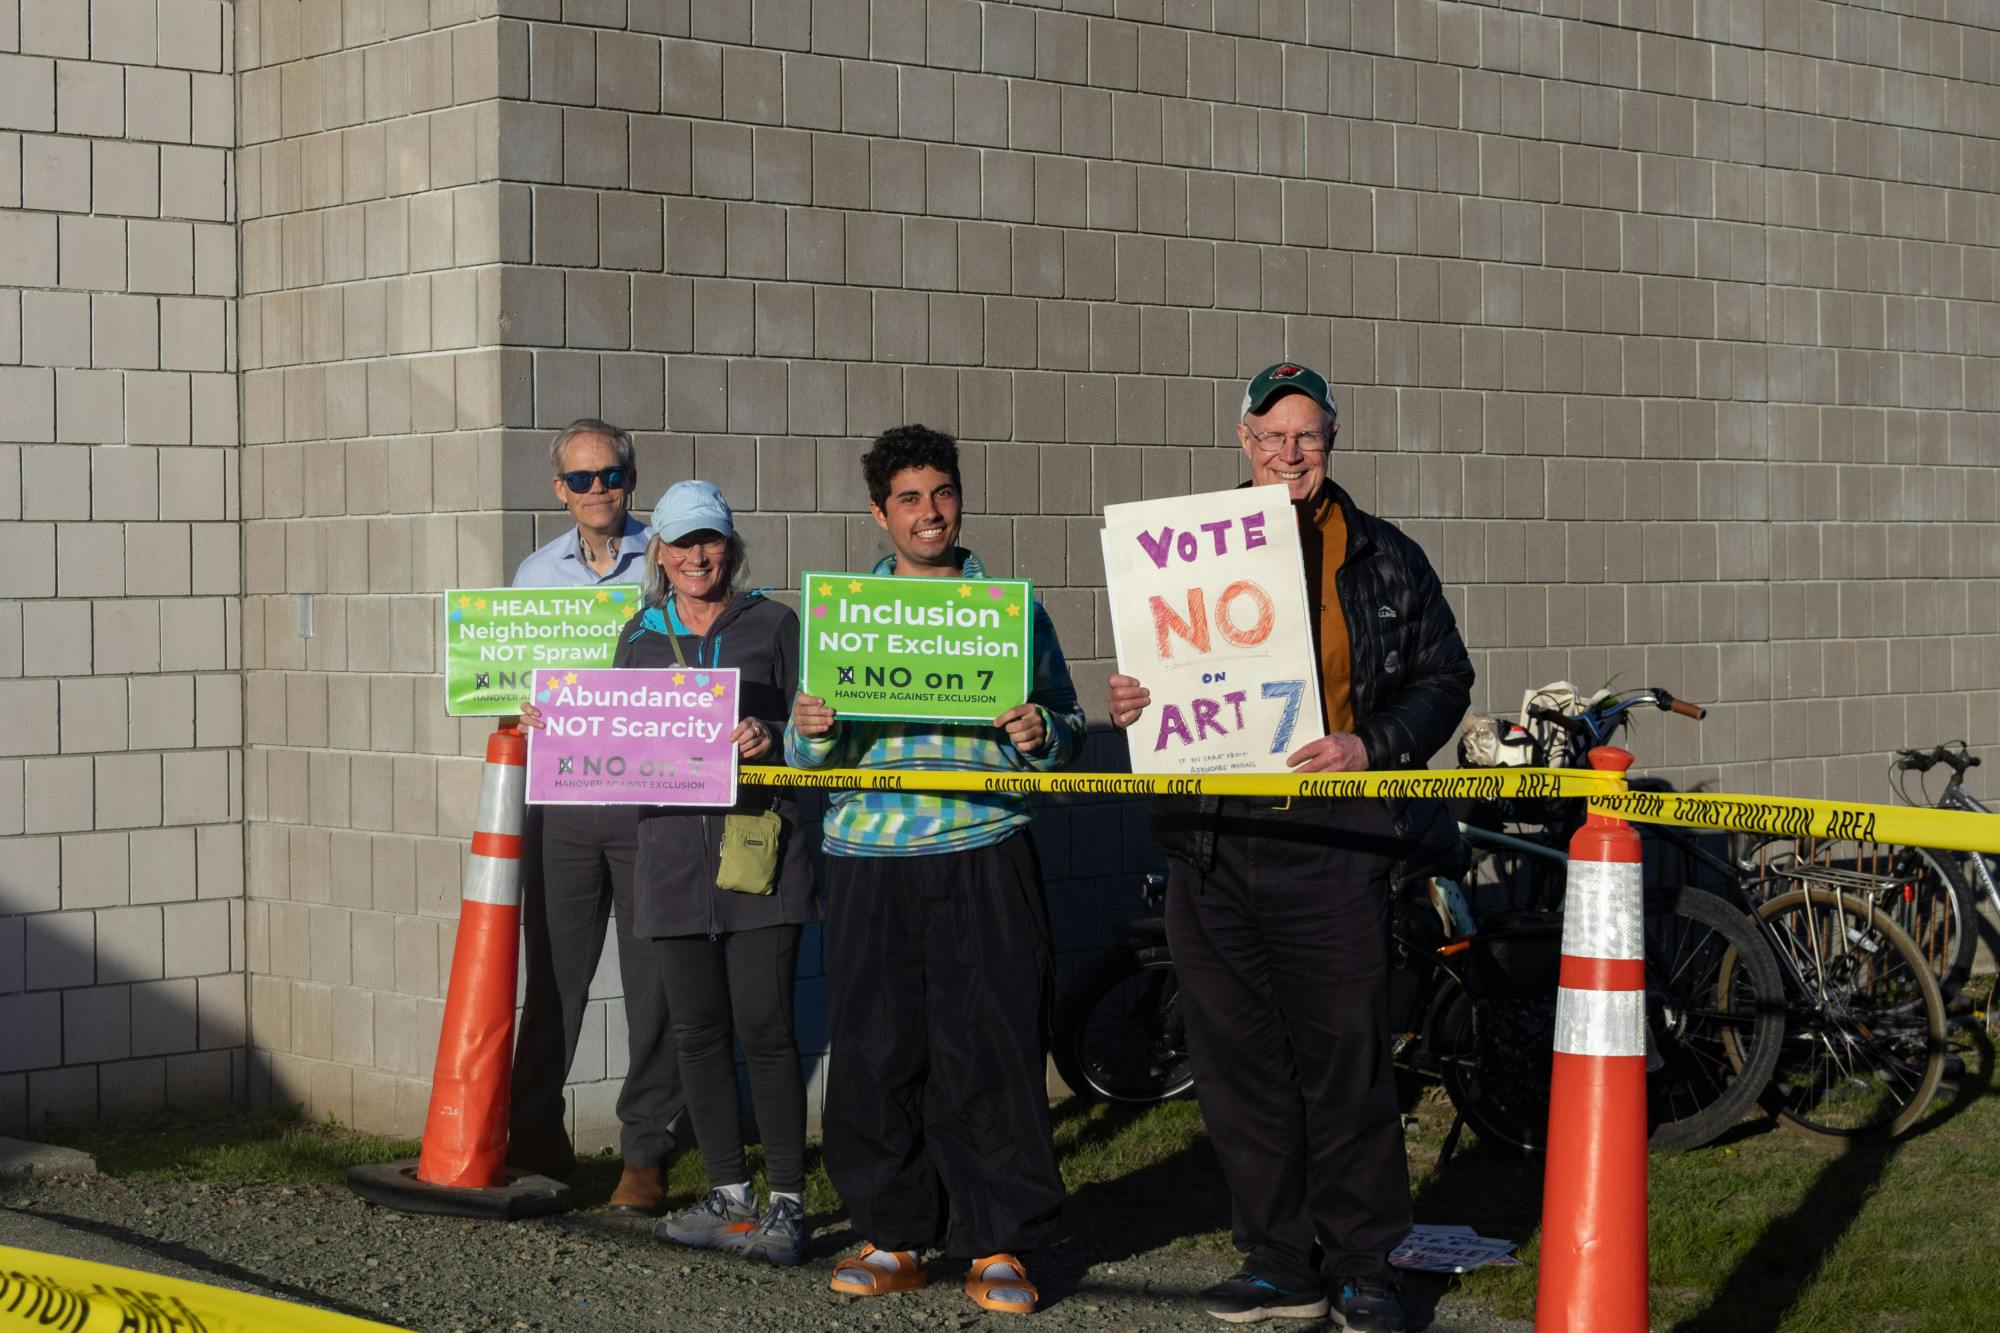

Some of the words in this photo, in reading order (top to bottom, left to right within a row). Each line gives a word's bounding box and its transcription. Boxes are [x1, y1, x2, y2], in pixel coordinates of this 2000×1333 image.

[1136, 511, 1267, 570] VOTE
[492, 598, 595, 616] HEALTHY
[839, 599, 1000, 628] Inclusion
[460, 620, 625, 642] Neighborhoods
[1148, 579, 1275, 661] NO
[480, 645, 527, 662] NOT
[533, 643, 608, 664] Sprawl
[819, 631, 879, 653] NOT
[888, 634, 1018, 658] Exclusion
[865, 666, 912, 688] NO
[925, 671, 964, 690] on
[977, 670, 994, 691] 7
[1201, 671, 1226, 685] ON
[473, 693, 518, 702] HANOVER
[555, 686, 715, 708] Abundance
[834, 690, 887, 701] HANOVER
[889, 692, 936, 702] AGAINST
[937, 693, 997, 704] EXCLUSION
[1154, 690, 1248, 752] ART
[1261, 680, 1307, 754] 7
[545, 716, 604, 738] NOT
[611, 715, 723, 743] Scarcity
[583, 755, 627, 776] NO
[639, 757, 676, 777] on
[555, 779, 602, 789] HANOVER
[604, 780, 648, 789] AGAINST
[650, 780, 705, 790] EXCLUSION
[1299, 779, 1368, 798] CAUTION
[1377, 775, 1505, 799] CONSTRUCTION
[1515, 773, 1562, 798] AREA
[1674, 797, 1815, 837] CONSTRUCTION
[1825, 810, 1877, 842] AREA
